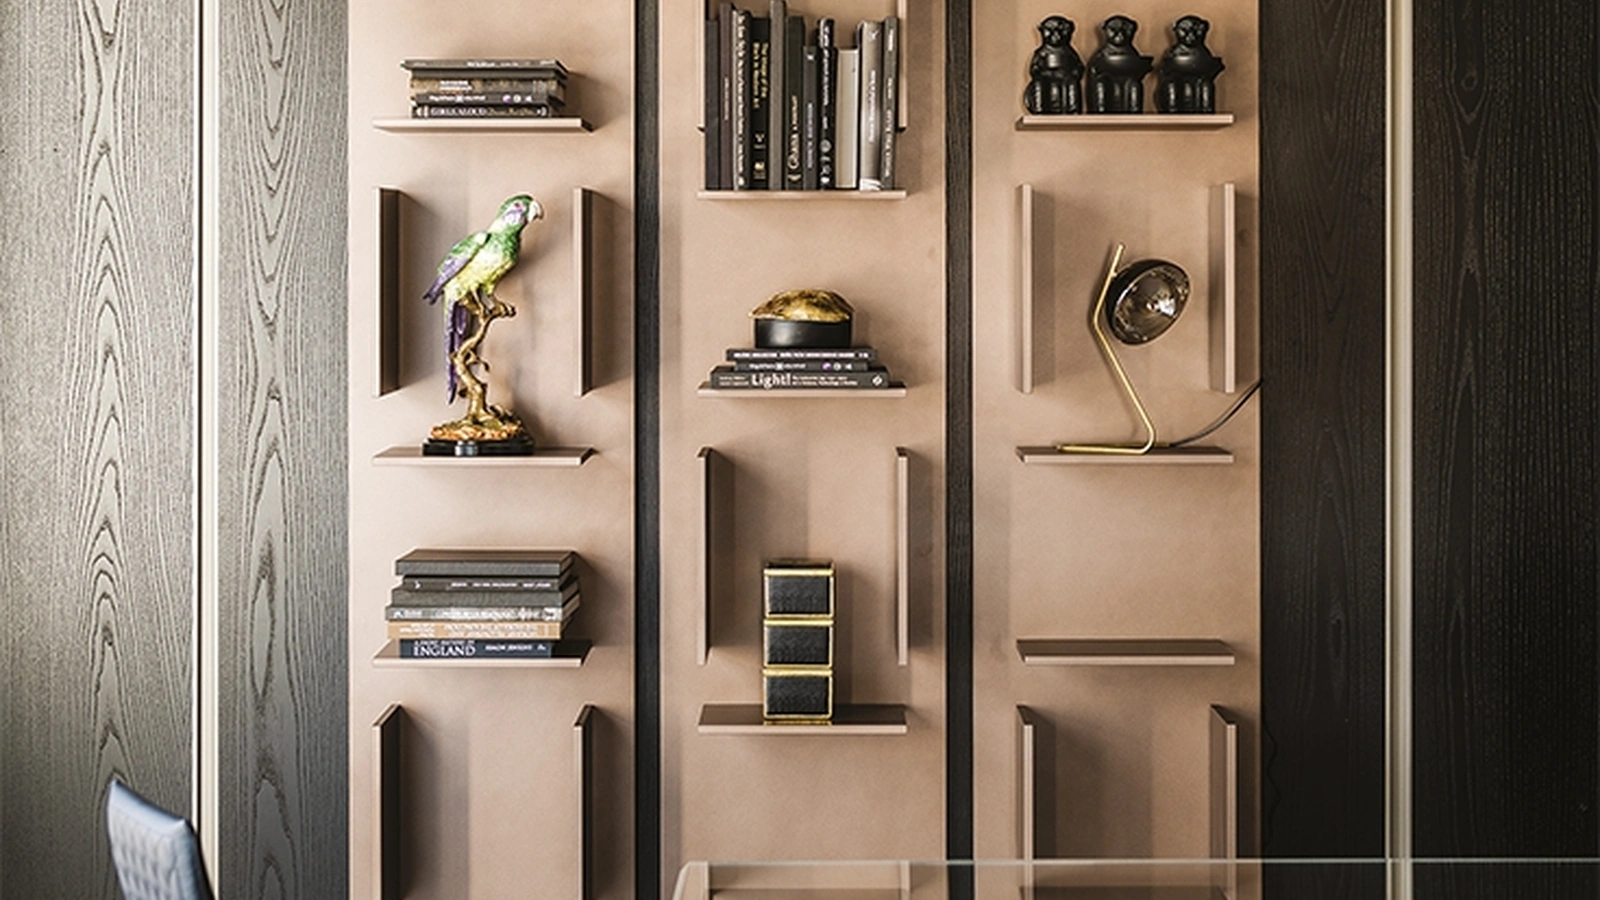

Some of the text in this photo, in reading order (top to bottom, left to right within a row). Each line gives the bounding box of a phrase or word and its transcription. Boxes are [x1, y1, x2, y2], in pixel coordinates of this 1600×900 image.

[787, 133, 799, 170] Ghana
[752, 373, 791, 390] Light!
[413, 645, 477, 657] ENGLAND
